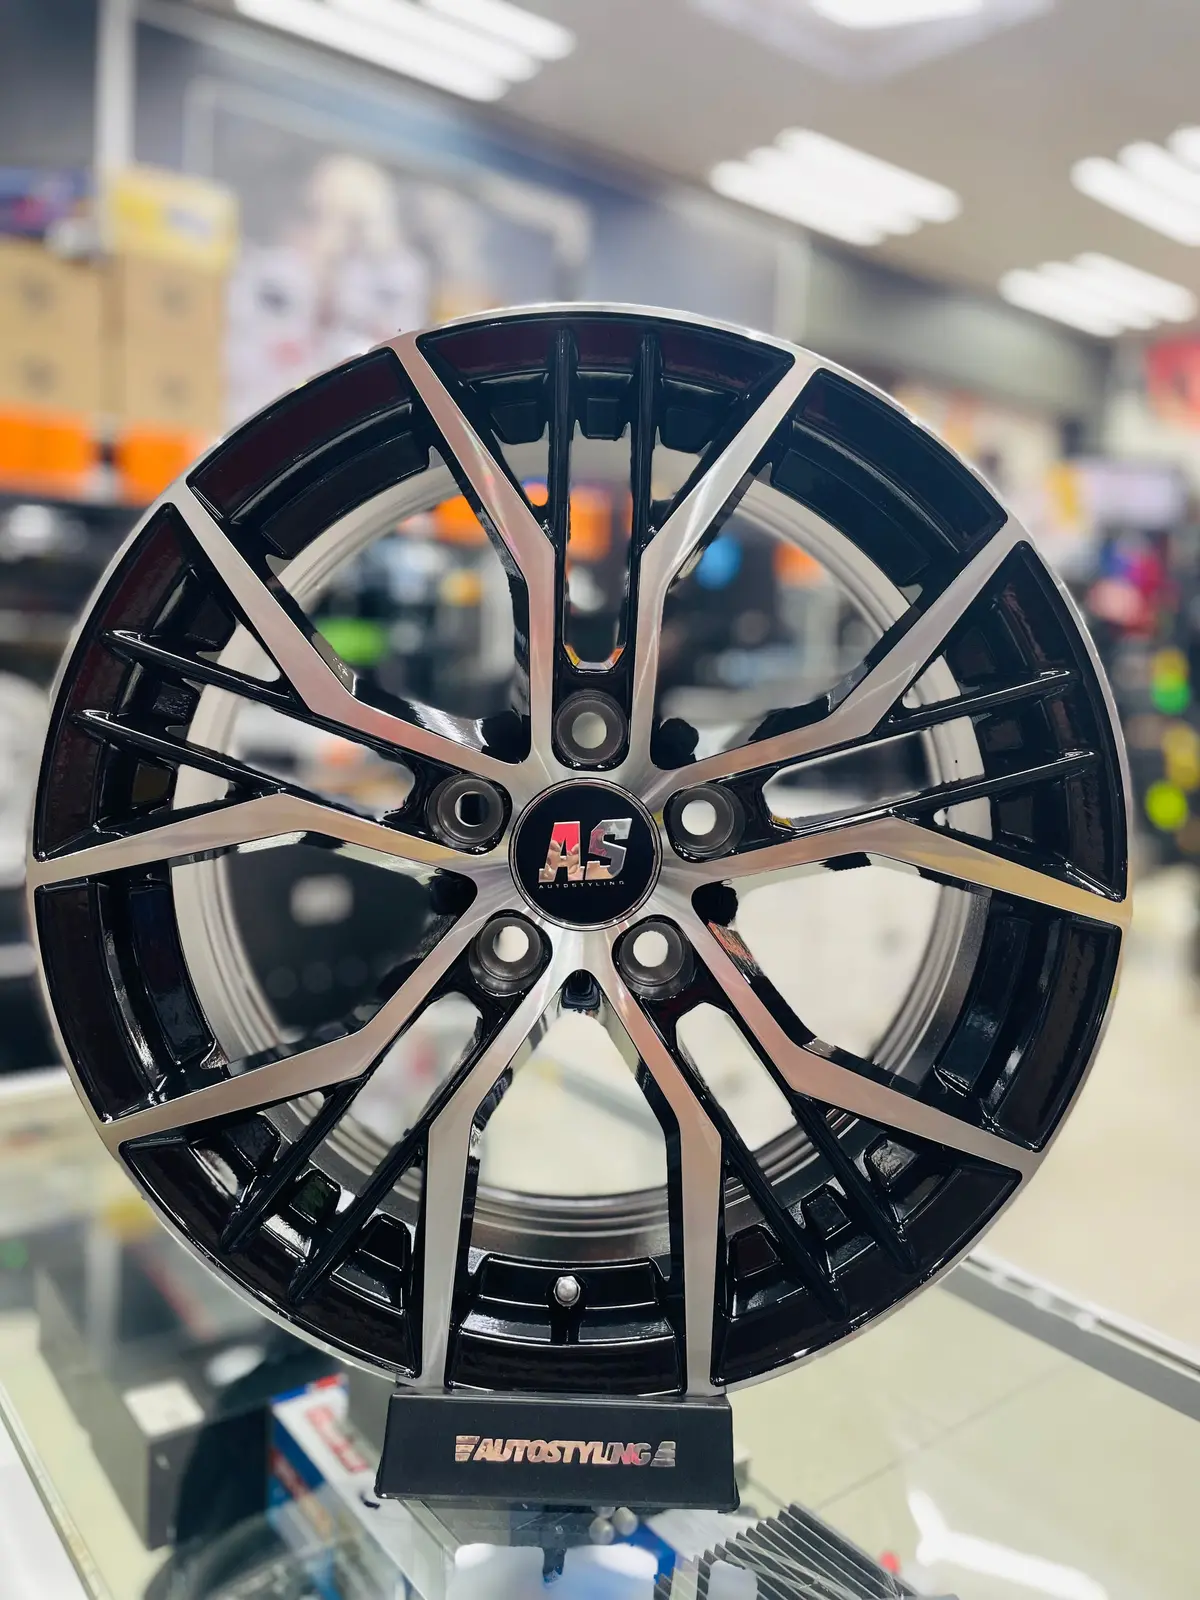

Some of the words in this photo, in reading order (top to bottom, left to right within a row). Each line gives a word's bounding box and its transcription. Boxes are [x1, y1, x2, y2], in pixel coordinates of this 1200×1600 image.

[538, 818, 632, 883] AS
[538, 881, 625, 889] AUTOSTYLING
[473, 1438, 652, 1465] AUTOSTYLING
